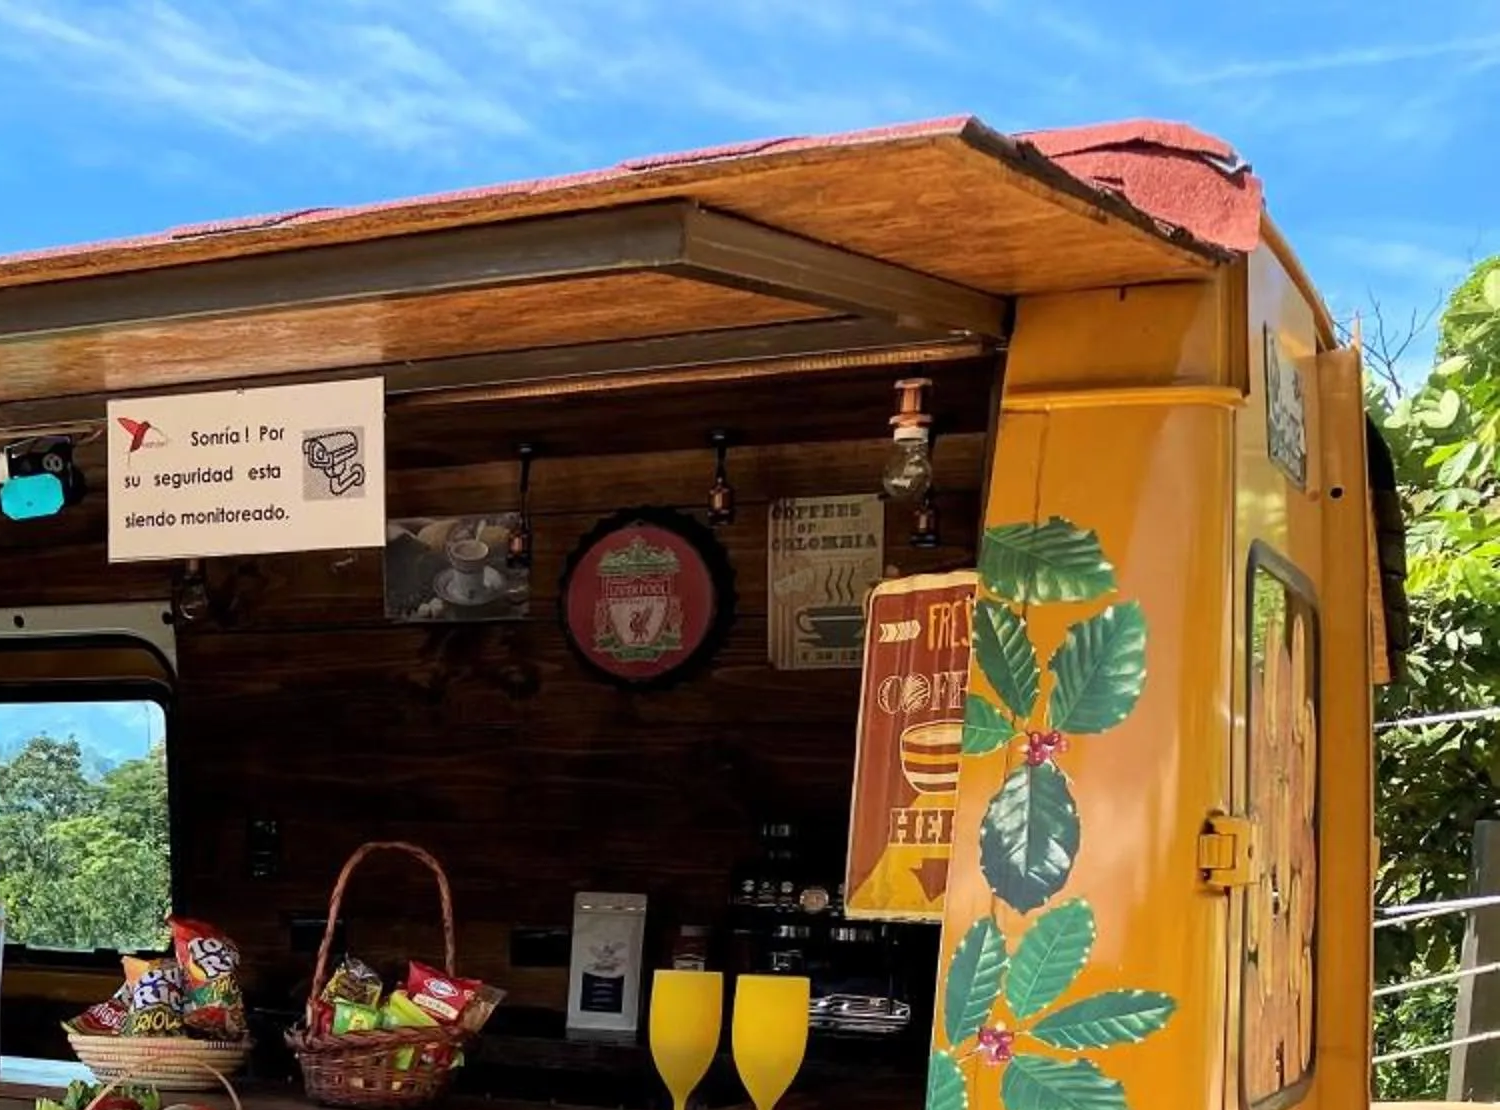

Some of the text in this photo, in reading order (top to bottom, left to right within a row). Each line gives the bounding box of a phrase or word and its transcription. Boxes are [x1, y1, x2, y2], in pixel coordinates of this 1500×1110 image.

[259, 425, 285, 441] Por
[124, 464, 282, 489] su seguridad esta
[125, 504, 291, 529] siendo monitoreado.
[877, 669, 968, 715] COFF
